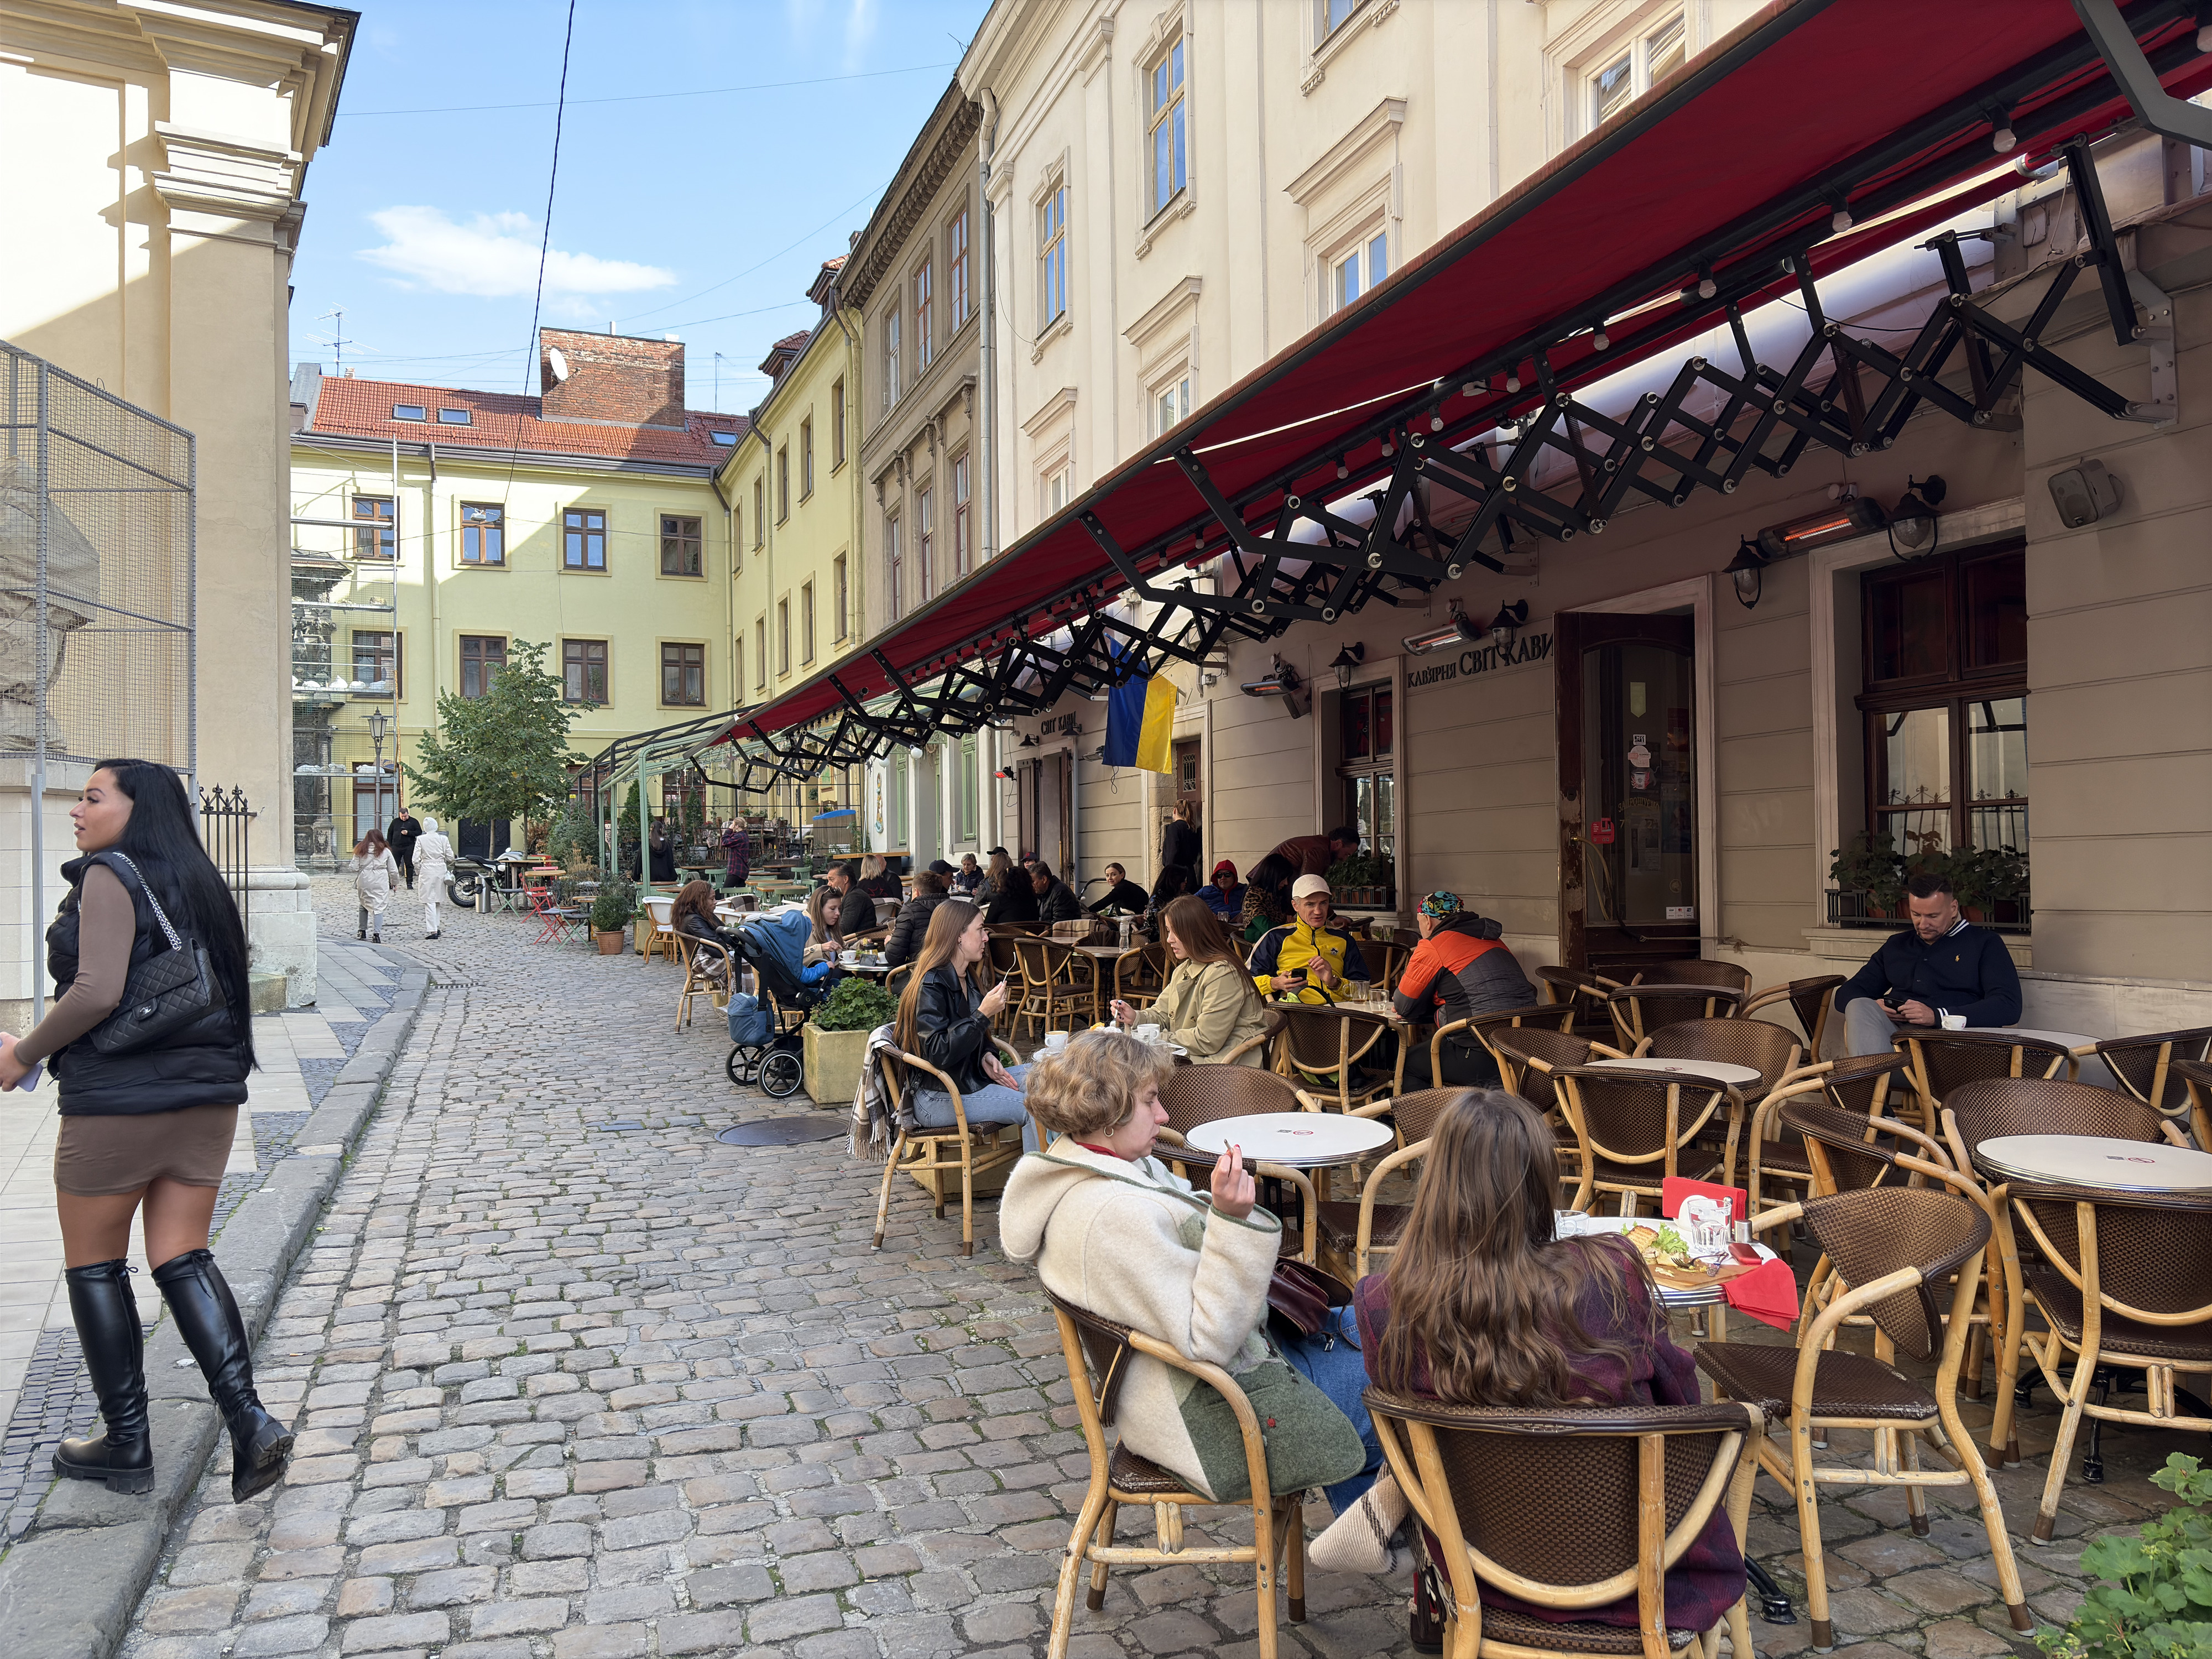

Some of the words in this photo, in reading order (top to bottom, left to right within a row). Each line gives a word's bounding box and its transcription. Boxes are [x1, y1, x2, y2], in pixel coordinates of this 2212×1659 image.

[1407, 662, 1457, 688] КАВ'ЯРНЯ
[1459, 646, 1496, 675] СВІТ
[1041, 717, 1057, 735] СВІТ
